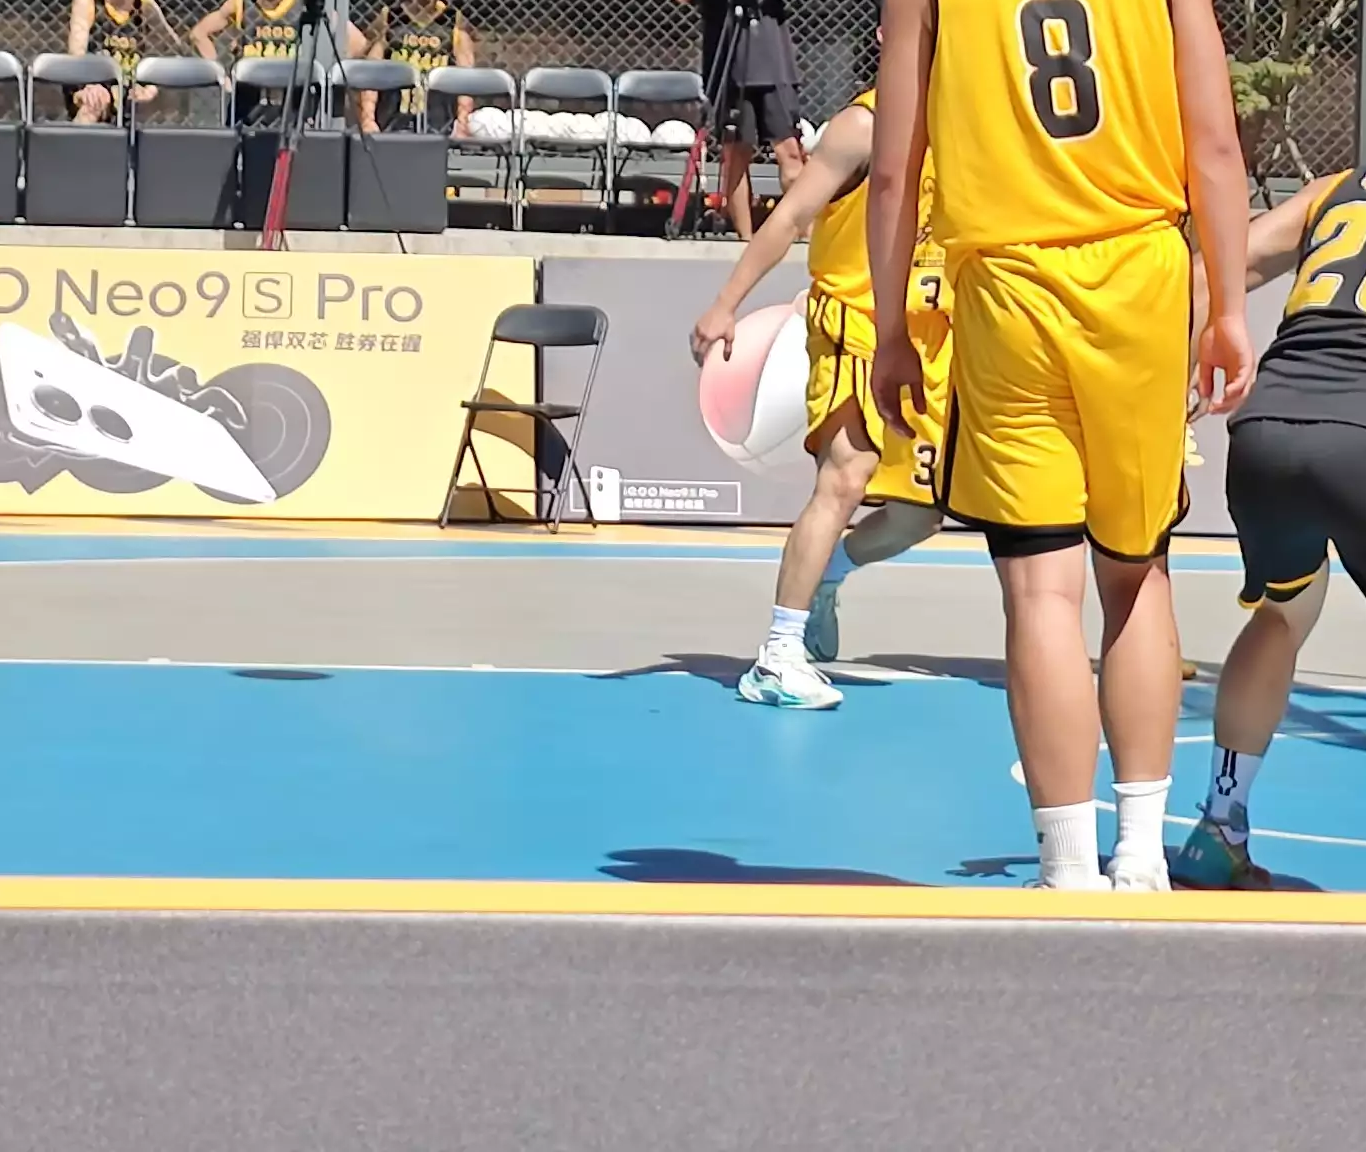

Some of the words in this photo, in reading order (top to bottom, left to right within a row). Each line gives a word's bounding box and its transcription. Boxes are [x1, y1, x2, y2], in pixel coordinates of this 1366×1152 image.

[316, 272, 424, 323] Pro
[241, 330, 329, 351] 强悍双芯
[334, 332, 422, 353] 胜券在握
[914, 444, 937, 486] 3
